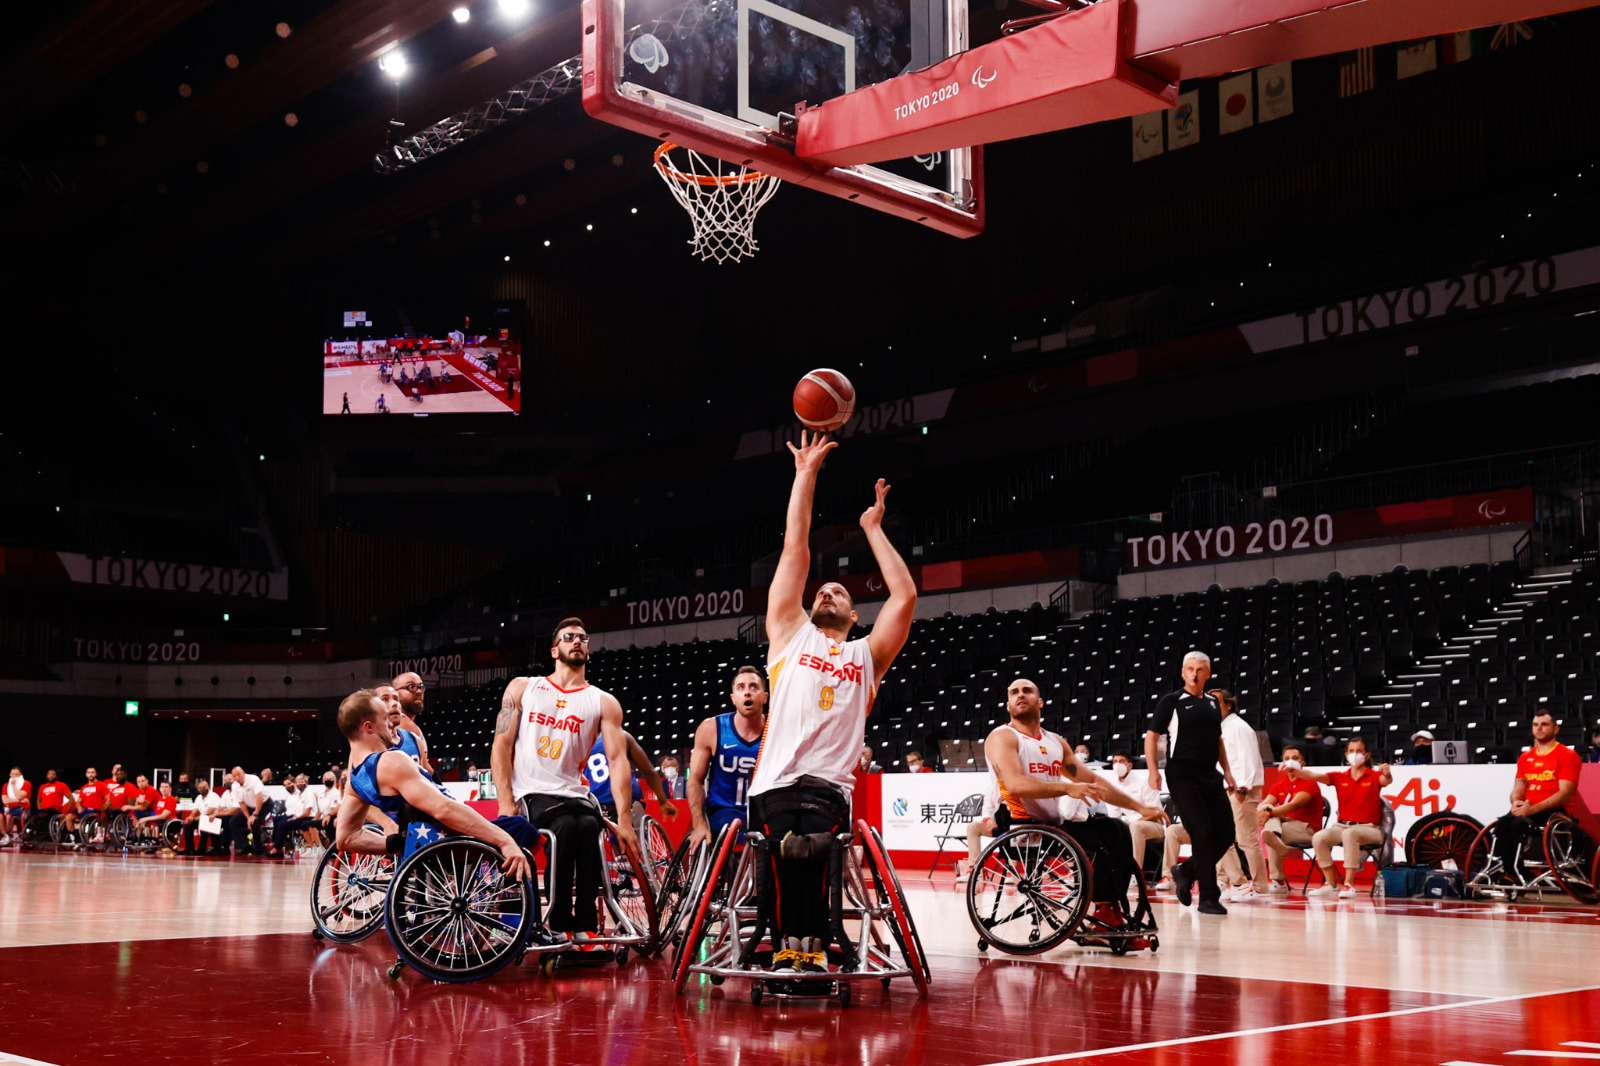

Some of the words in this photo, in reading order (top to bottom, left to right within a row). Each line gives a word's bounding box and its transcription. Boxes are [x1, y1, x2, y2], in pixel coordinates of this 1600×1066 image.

[894, 95, 930, 121] TOKYO
[931, 82, 959, 105] 2020
[1296, 283, 1432, 345] TOKYO
[1445, 255, 1556, 314] 2020
[1127, 525, 1235, 567] TOKYO
[1244, 513, 1333, 554] 2020
[86, 554, 191, 592] TOKYO
[200, 566, 271, 598] 2020
[627, 595, 690, 625] TOKYO
[694, 588, 744, 618] 2020
[74, 637, 143, 661] TOKYO
[147, 641, 200, 662] 2020
[388, 657, 428, 679] TOKYO
[429, 653, 462, 674] 2020
[818, 685, 835, 711] 9
[528, 711, 586, 734] ESPAÑA
[537, 735, 564, 760] 28
[587, 752, 610, 783] 8
[719, 754, 757, 773] US
